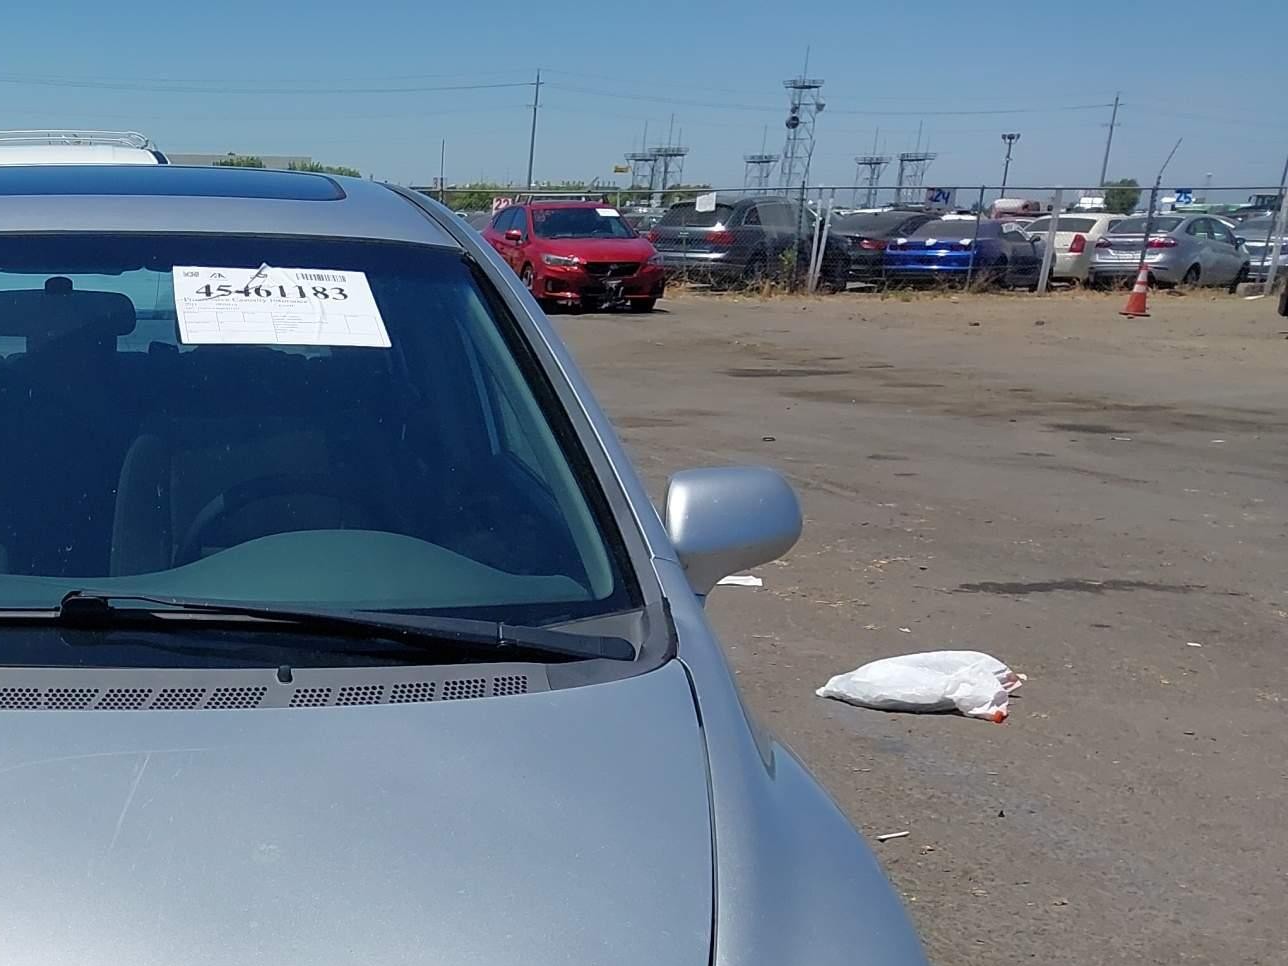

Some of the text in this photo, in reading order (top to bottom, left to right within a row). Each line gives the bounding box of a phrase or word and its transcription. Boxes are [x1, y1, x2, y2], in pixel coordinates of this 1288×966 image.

[494, 198, 510, 211] 22
[932, 190, 951, 205] 24
[1175, 191, 1192, 205] 25
[195, 283, 349, 301] 45461183
